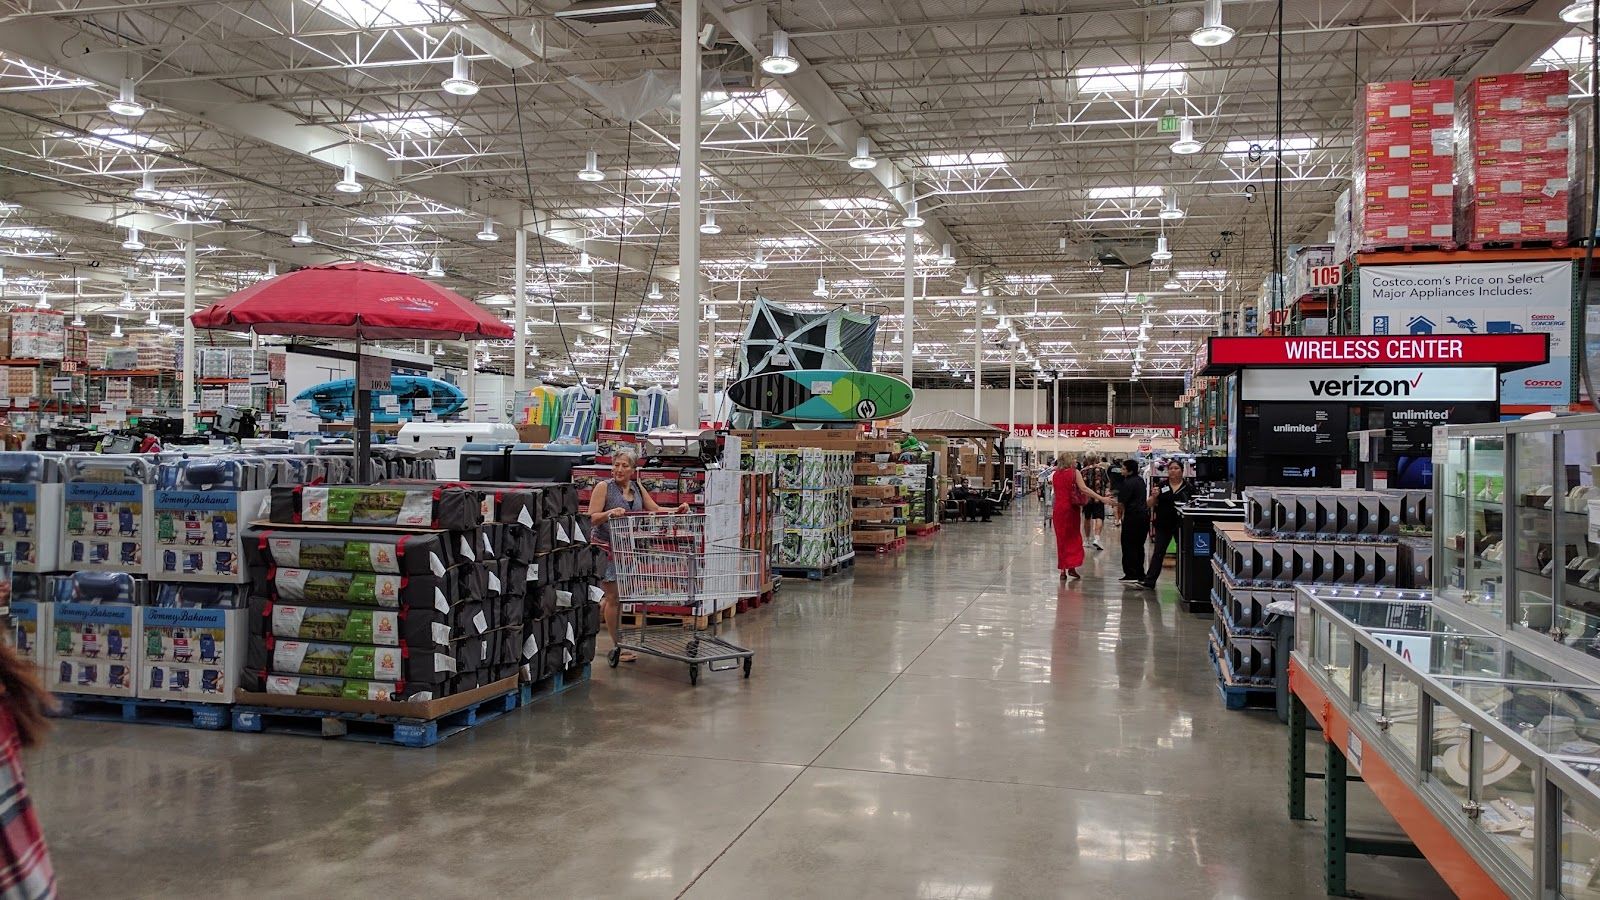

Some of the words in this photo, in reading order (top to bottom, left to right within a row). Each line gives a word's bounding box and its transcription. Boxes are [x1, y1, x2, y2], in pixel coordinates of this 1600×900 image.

[1162, 118, 1177, 130] EXIT
[1312, 266, 1340, 286] 105
[1372, 275, 1451, 287] Costco.com's
[1455, 274, 1485, 285] Price
[1488, 277, 1504, 285] on
[1507, 274, 1545, 284] Select
[1372, 287, 1406, 301] Major
[1409, 286, 1475, 301] Appliances
[1478, 286, 1533, 297] Includes:
[1267, 310, 1289, 325] 107
[1374, 317, 1384, 328] 2
[1285, 339, 1380, 360] WIRELESS
[1386, 339, 1463, 360] CENTER
[1309, 374, 1410, 396] verizon
[1392, 409, 1449, 420] unlimited
[1013, 429, 1029, 437] SDA
[1089, 429, 1111, 438] PORK
[1273, 424, 1317, 433] unlimited
[1303, 466, 1317, 478] #1
[0, 486, 29, 496] ahama
[71, 485, 99, 499] Tommy
[100, 485, 137, 497] Bahama
[159, 492, 190, 507] Tommy
[190, 493, 230, 505] Bahama
[59, 606, 88, 619] Tommy
[89, 606, 125, 619] Bahama
[149, 610, 179, 624] Tommy
[178, 610, 218, 622] Bahama
